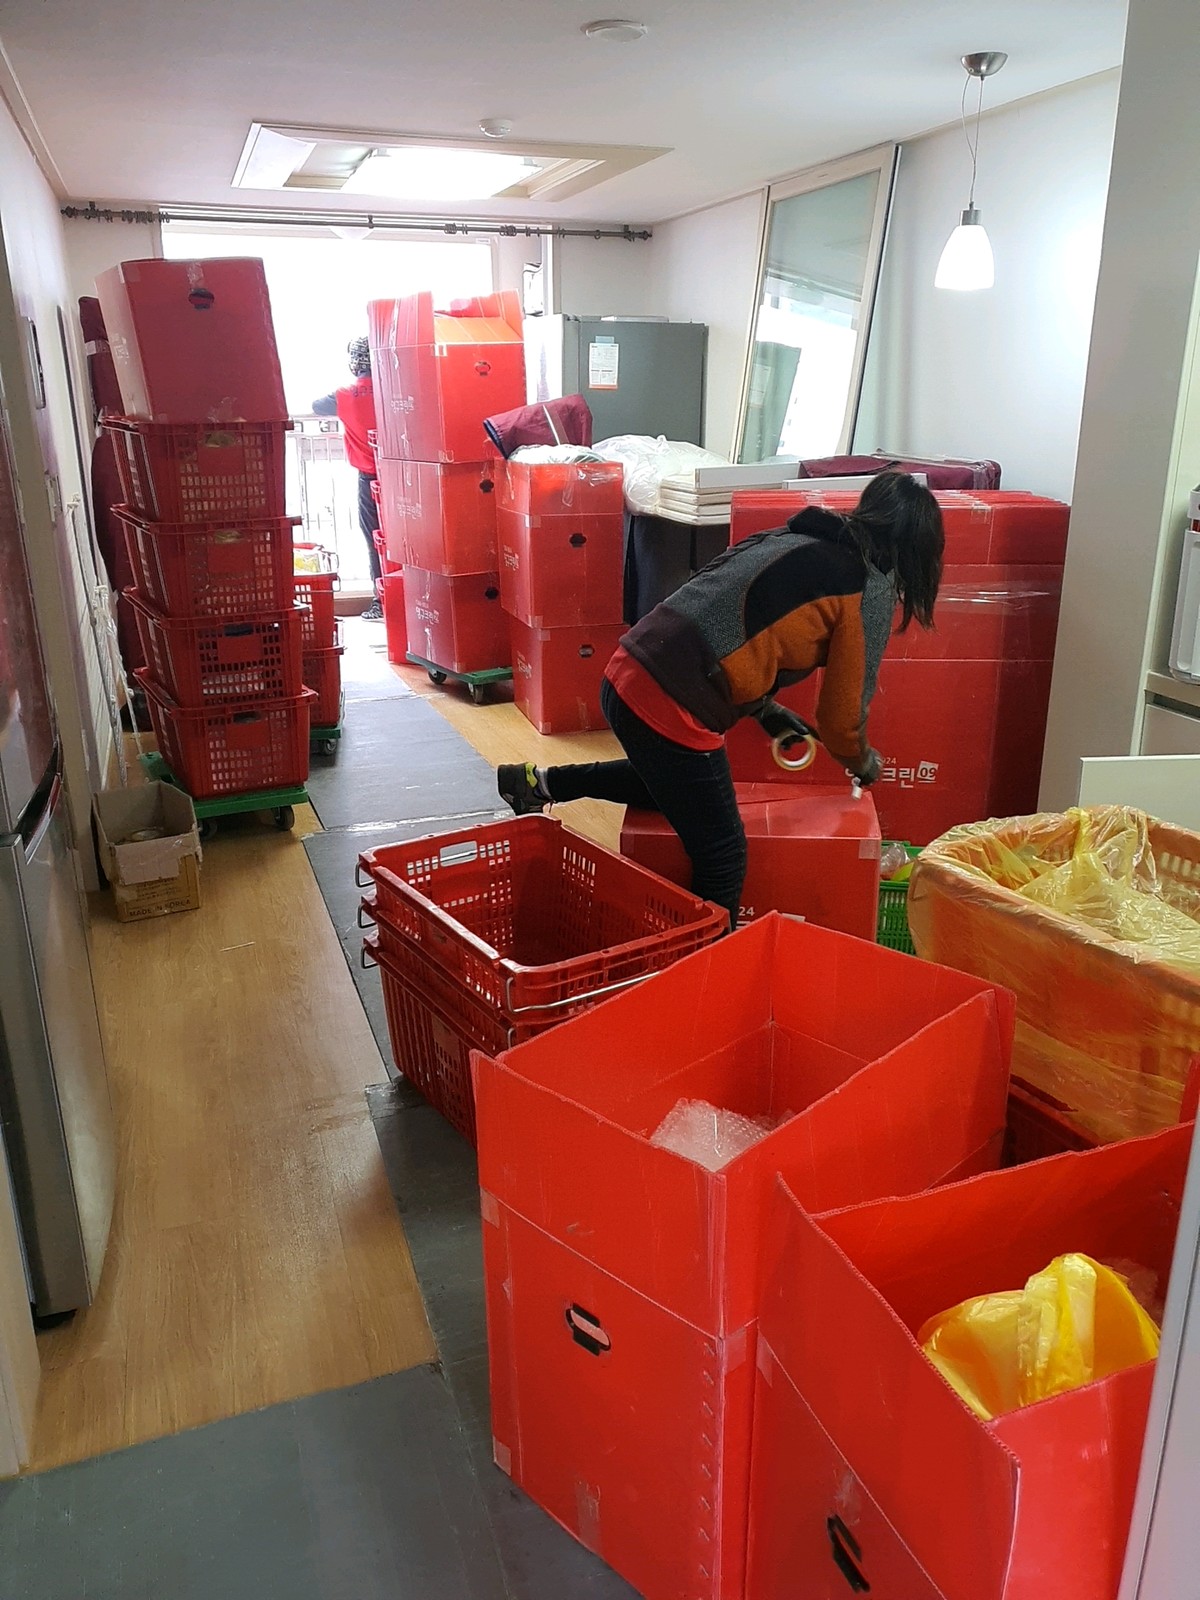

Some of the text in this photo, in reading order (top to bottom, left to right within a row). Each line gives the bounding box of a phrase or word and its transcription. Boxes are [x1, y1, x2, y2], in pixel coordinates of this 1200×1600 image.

[129, 908, 152, 917] MADE
[164, 899, 191, 909] KOREA
[738, 906, 755, 916] 24
